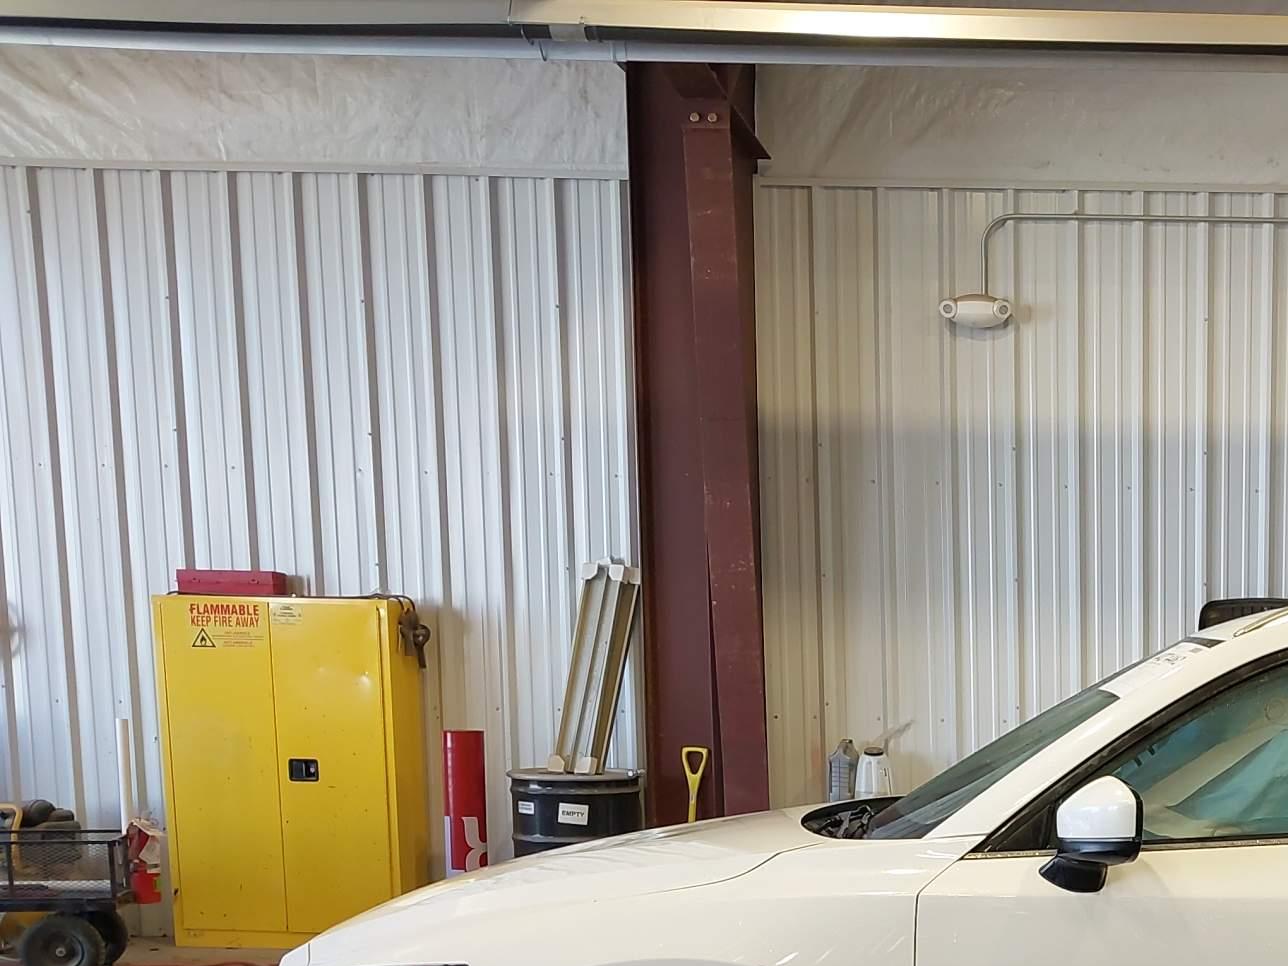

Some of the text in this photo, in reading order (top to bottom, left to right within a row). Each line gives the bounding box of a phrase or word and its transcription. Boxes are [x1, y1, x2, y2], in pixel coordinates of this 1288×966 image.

[189, 603, 260, 616] FLAMMABLE
[190, 615, 260, 628] KEEP FIRE AWAY
[561, 810, 585, 818] EMPTY
